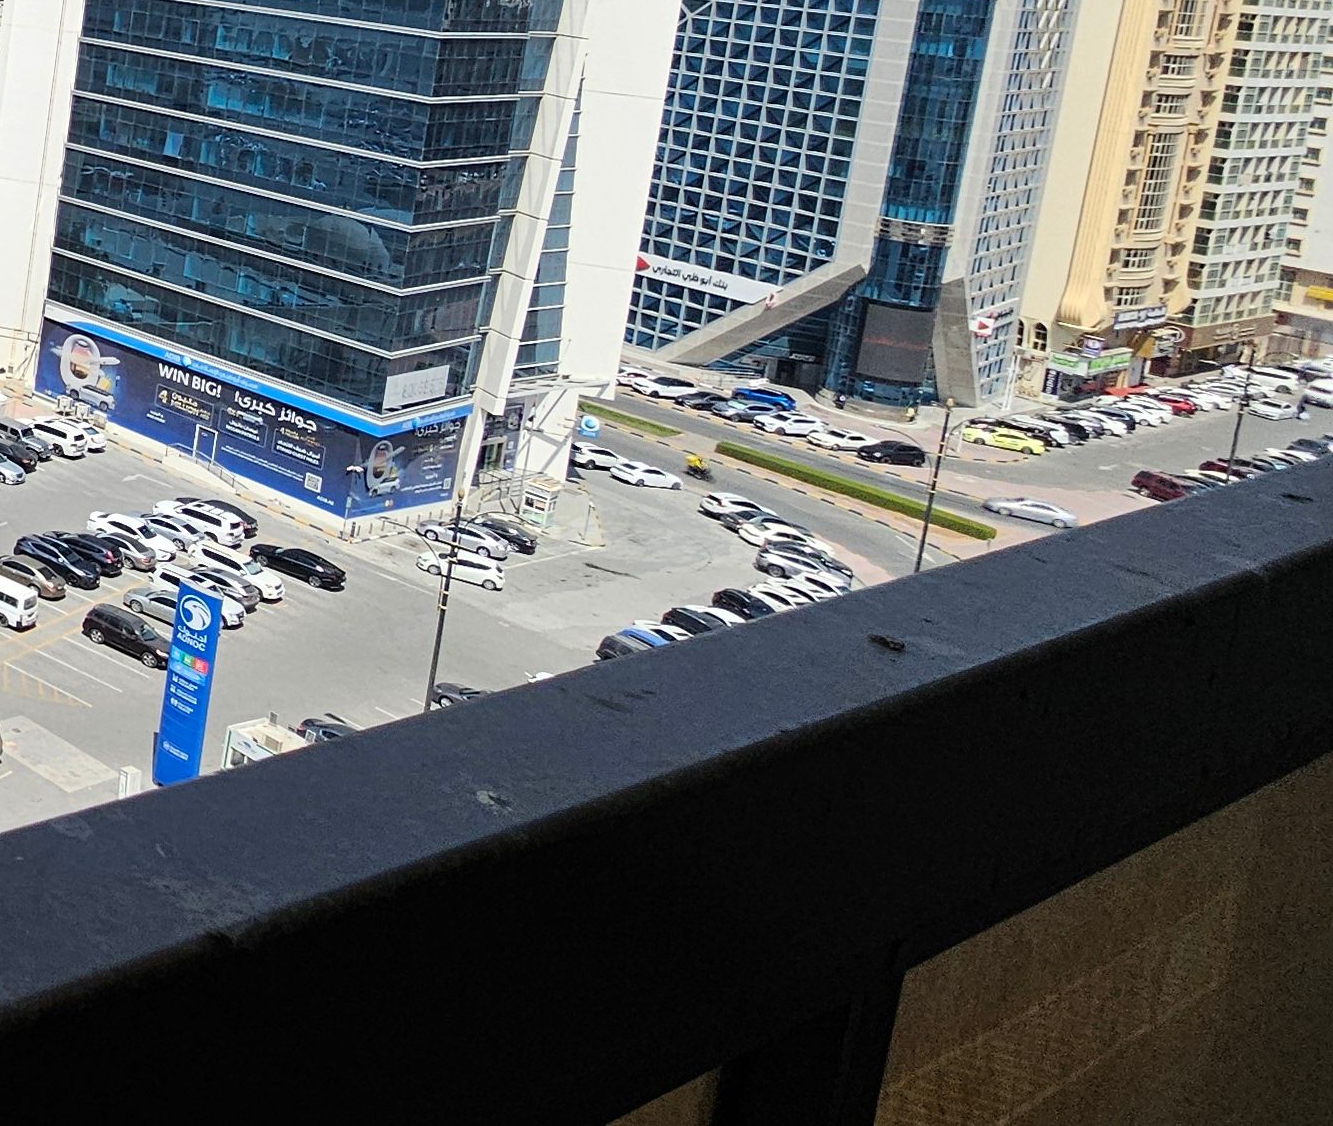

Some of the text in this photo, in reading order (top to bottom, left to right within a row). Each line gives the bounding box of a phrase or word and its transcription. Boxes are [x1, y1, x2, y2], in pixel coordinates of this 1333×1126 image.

[158, 362, 222, 398] WIN BIG!
[158, 390, 168, 404] 4
[277, 407, 317, 433] جوائز
[176, 632, 206, 652] ADNOC
